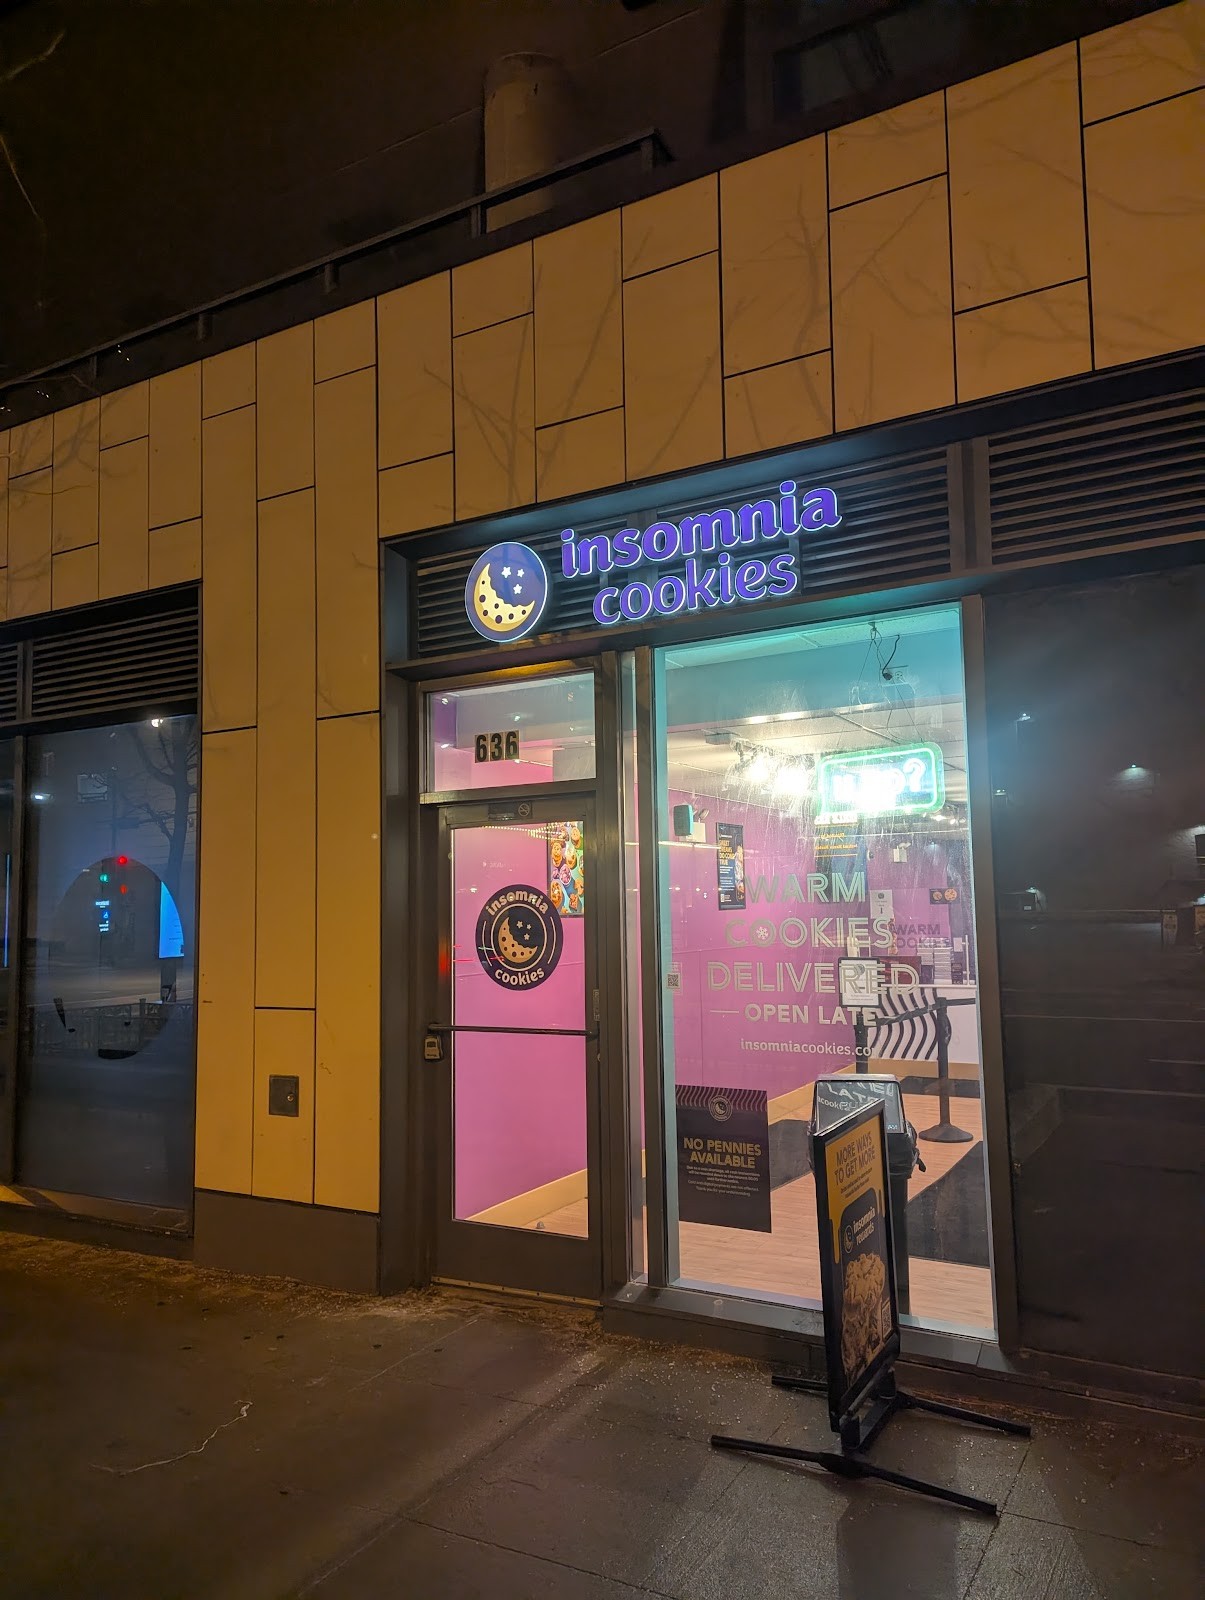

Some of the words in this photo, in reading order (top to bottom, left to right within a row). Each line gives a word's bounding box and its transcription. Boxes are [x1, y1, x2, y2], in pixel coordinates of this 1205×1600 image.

[561, 480, 842, 578] insomnia
[593, 553, 798, 624] cookies
[475, 732, 519, 762] 636
[745, 872, 865, 903] WARM
[486, 891, 549, 916] insomnia
[725, 917, 893, 948] COOKIES
[495, 968, 545, 985] cookies
[707, 961, 920, 994] DELIVERED
[745, 1003, 809, 1024] OPEN
[818, 1006, 877, 1027] LATE
[741, 1038, 876, 1057] insomniacookies.co
[683, 1137, 704, 1151] NO
[706, 1139, 762, 1156] PENNIES
[690, 1151, 756, 1169] AVAILABLE
[836, 1141, 856, 1167] MORE
[855, 1131, 873, 1154] WAYS
[834, 1167, 845, 1186] TO
[845, 1157, 858, 1178] GET
[858, 1145, 876, 1169] MORE
[853, 1206, 876, 1234] insomnia
